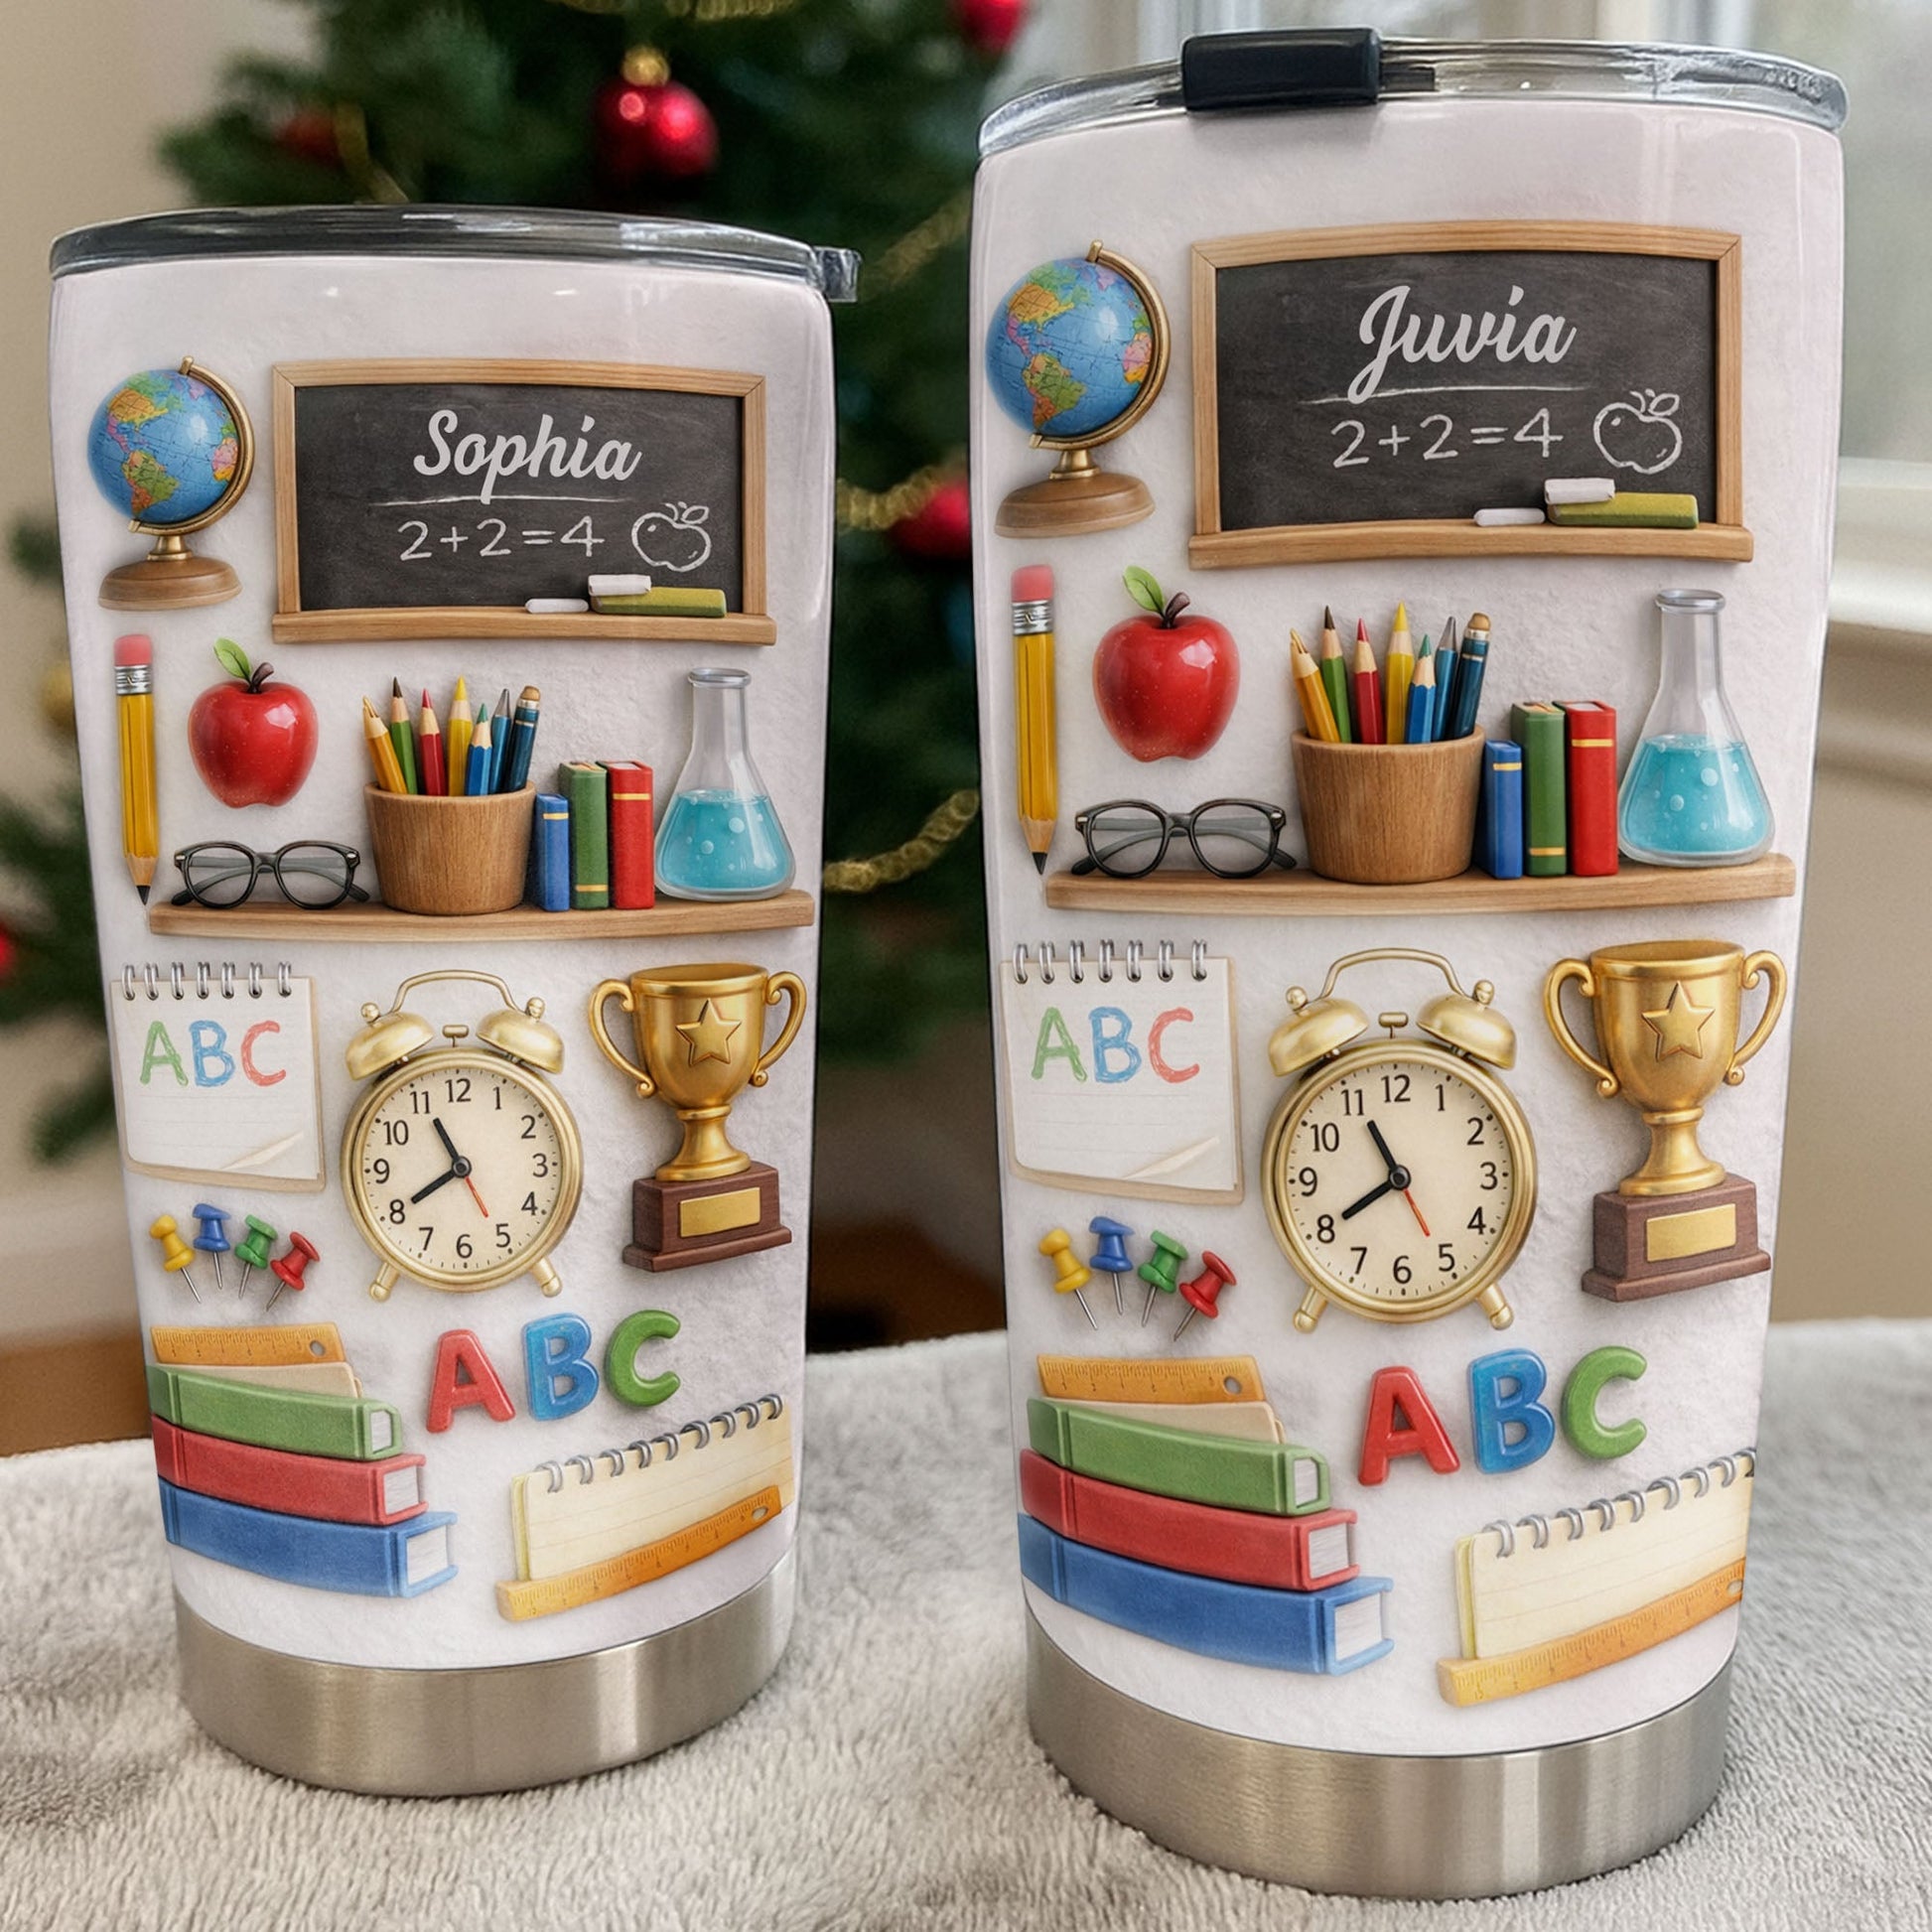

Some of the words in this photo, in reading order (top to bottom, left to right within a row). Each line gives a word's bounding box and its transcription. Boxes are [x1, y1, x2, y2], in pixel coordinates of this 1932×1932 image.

[1348, 286, 1577, 404] Juvia
[413, 410, 641, 504] Sophia
[140, 1020, 286, 1087] ABC
[1032, 1007, 1199, 1083] ABC
[445, 1078, 471, 1103] 12
[493, 1087, 501, 1110] 1
[1381, 1074, 1411, 1103] 12
[1436, 1084, 1445, 1111] 1
[410, 1091, 430, 1114] 11
[1341, 1089, 1364, 1116] 11
[382, 1120, 409, 1146] 10
[520, 1115, 536, 1139] 2
[1311, 1123, 1339, 1152] 10
[1467, 1118, 1484, 1145] 2
[373, 1159, 390, 1183] 9
[532, 1154, 548, 1177] 3
[1480, 1162, 1497, 1189] 3
[1299, 1167, 1317, 1196] 9
[389, 1199, 405, 1224] 8
[521, 1191, 538, 1215] 4
[1317, 1214, 1335, 1244] 8
[1467, 1206, 1486, 1234] 4
[419, 1227, 434, 1251] 7
[457, 1234, 473, 1258] 6
[496, 1223, 511, 1248] 5
[1350, 1247, 1367, 1275] 7
[1393, 1256, 1412, 1284] 6
[1439, 1244, 1454, 1272] 5
[426, 1310, 681, 1434] ABC
[1358, 1345, 1648, 1486] ABC
